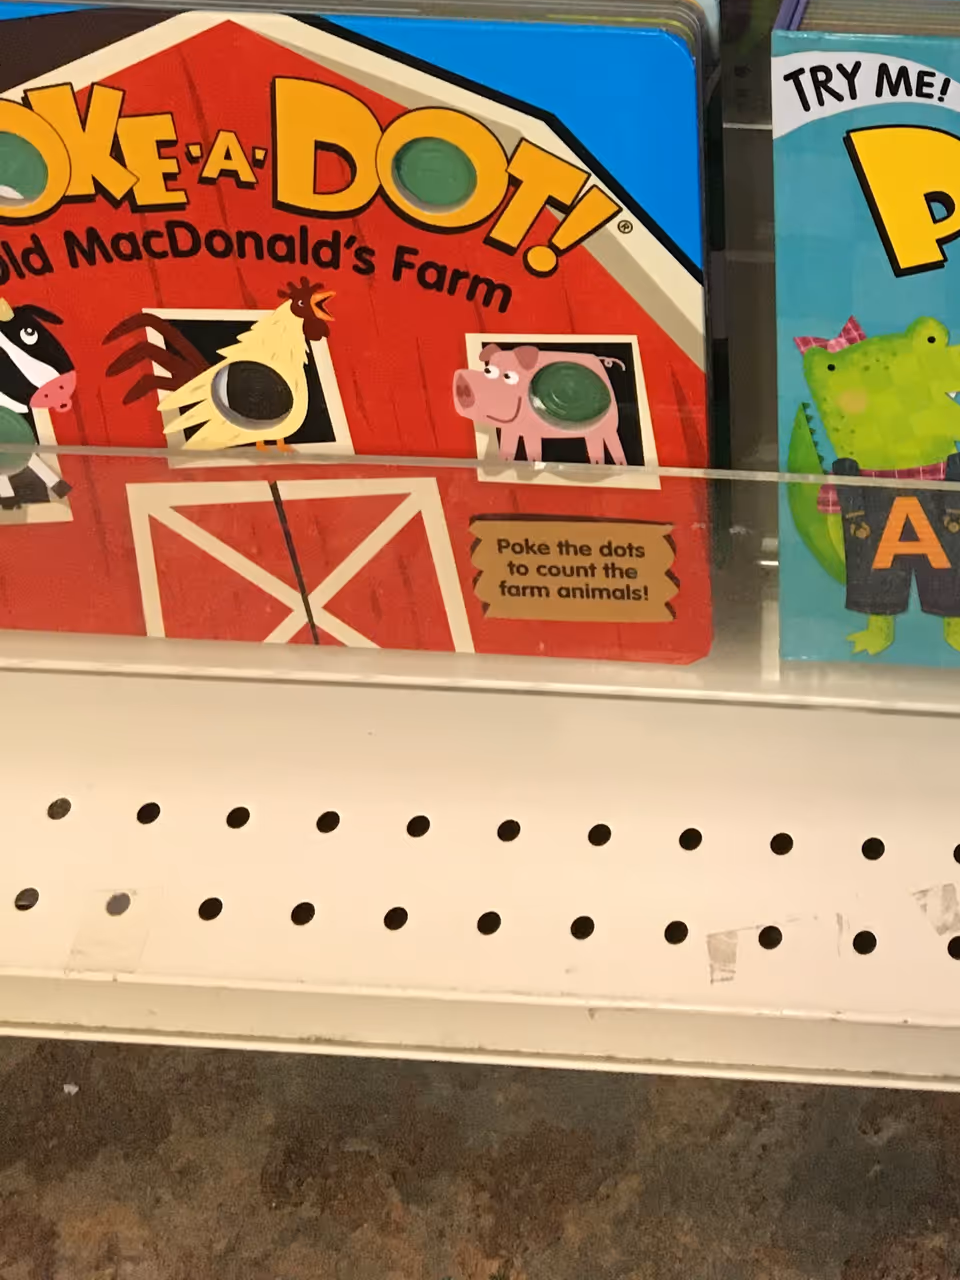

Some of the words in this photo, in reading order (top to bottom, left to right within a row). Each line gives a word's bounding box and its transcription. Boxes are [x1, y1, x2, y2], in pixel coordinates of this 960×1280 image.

[783, 60, 862, 112] TRY
[875, 62, 952, 103] ME!
[0, 233, 54, 285] ld
[62, 219, 376, 277] MacDonald's
[392, 244, 513, 314] Farm
[496, 538, 551, 556] Poke
[556, 540, 593, 557] the
[598, 540, 646, 559] dots
[871, 495, 953, 570] A
[507, 561, 530, 577] to
[536, 563, 598, 579] count
[602, 562, 638, 580] the
[498, 580, 551, 598] farm
[557, 584, 650, 602] animals!
